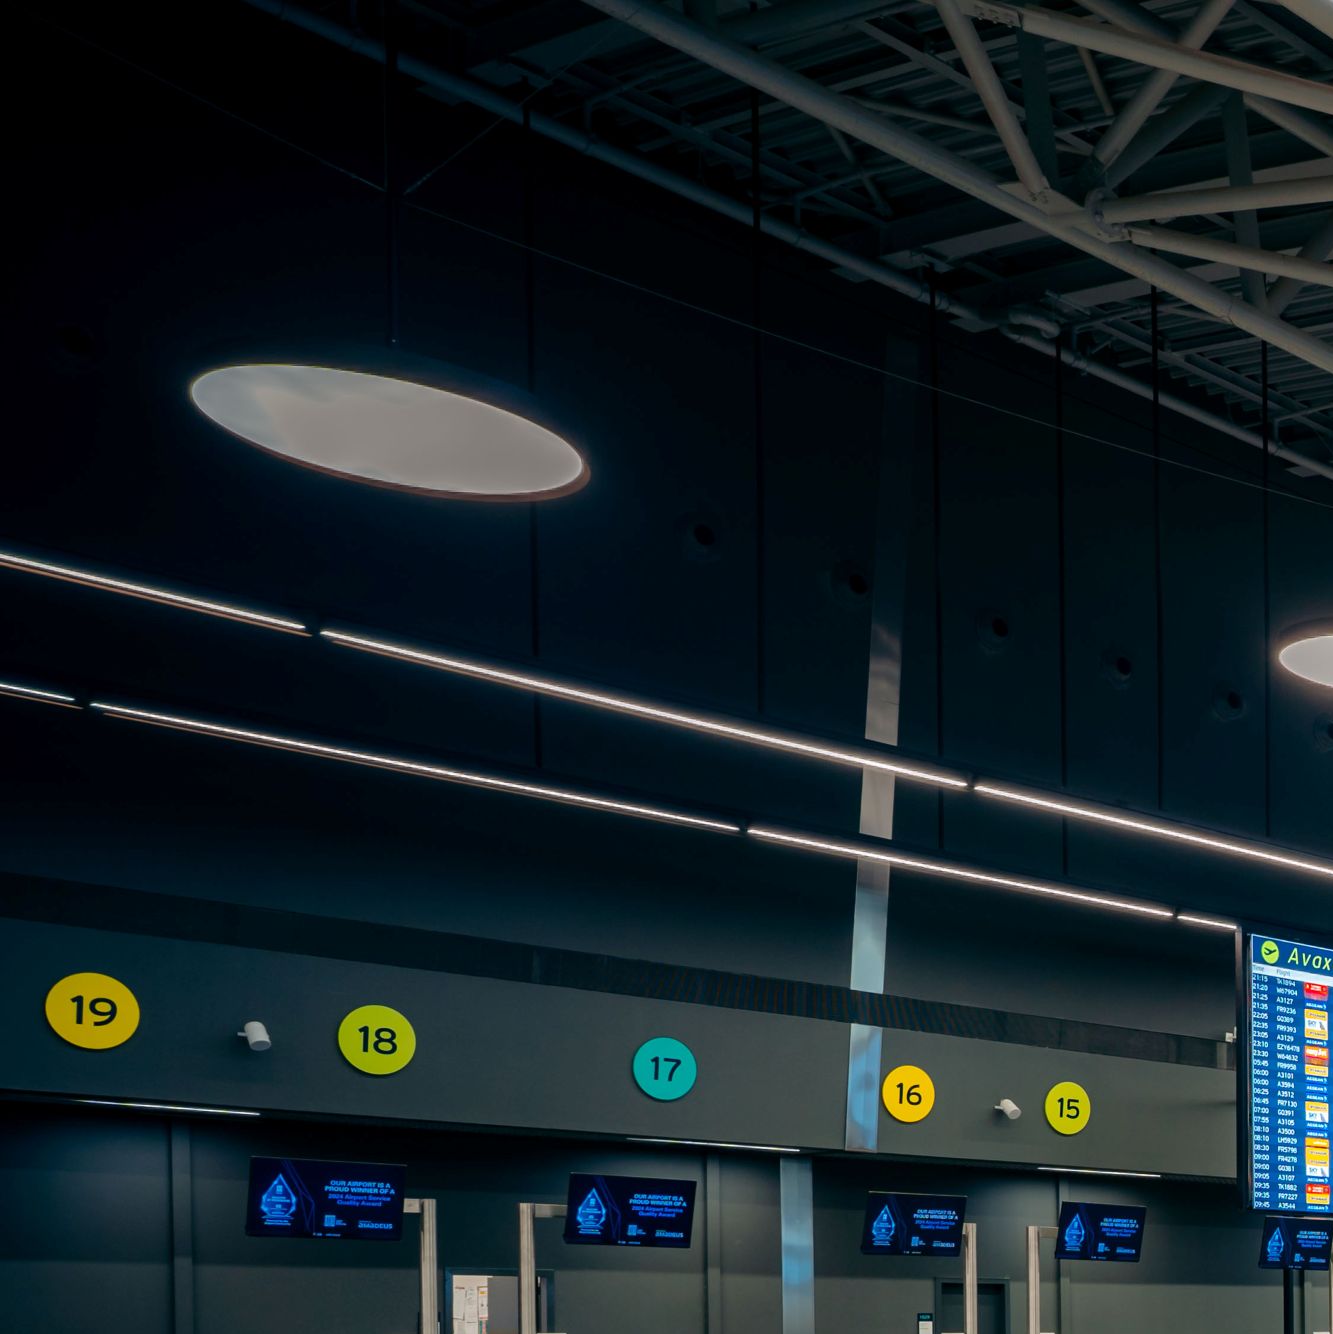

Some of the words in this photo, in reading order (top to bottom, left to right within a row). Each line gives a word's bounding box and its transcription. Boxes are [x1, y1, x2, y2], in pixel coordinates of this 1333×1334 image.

[70, 995, 117, 1026] 19
[358, 1026, 397, 1055] 18
[650, 1056, 681, 1082] 17
[896, 1083, 922, 1106] 16
[1057, 1097, 1080, 1119] 15
